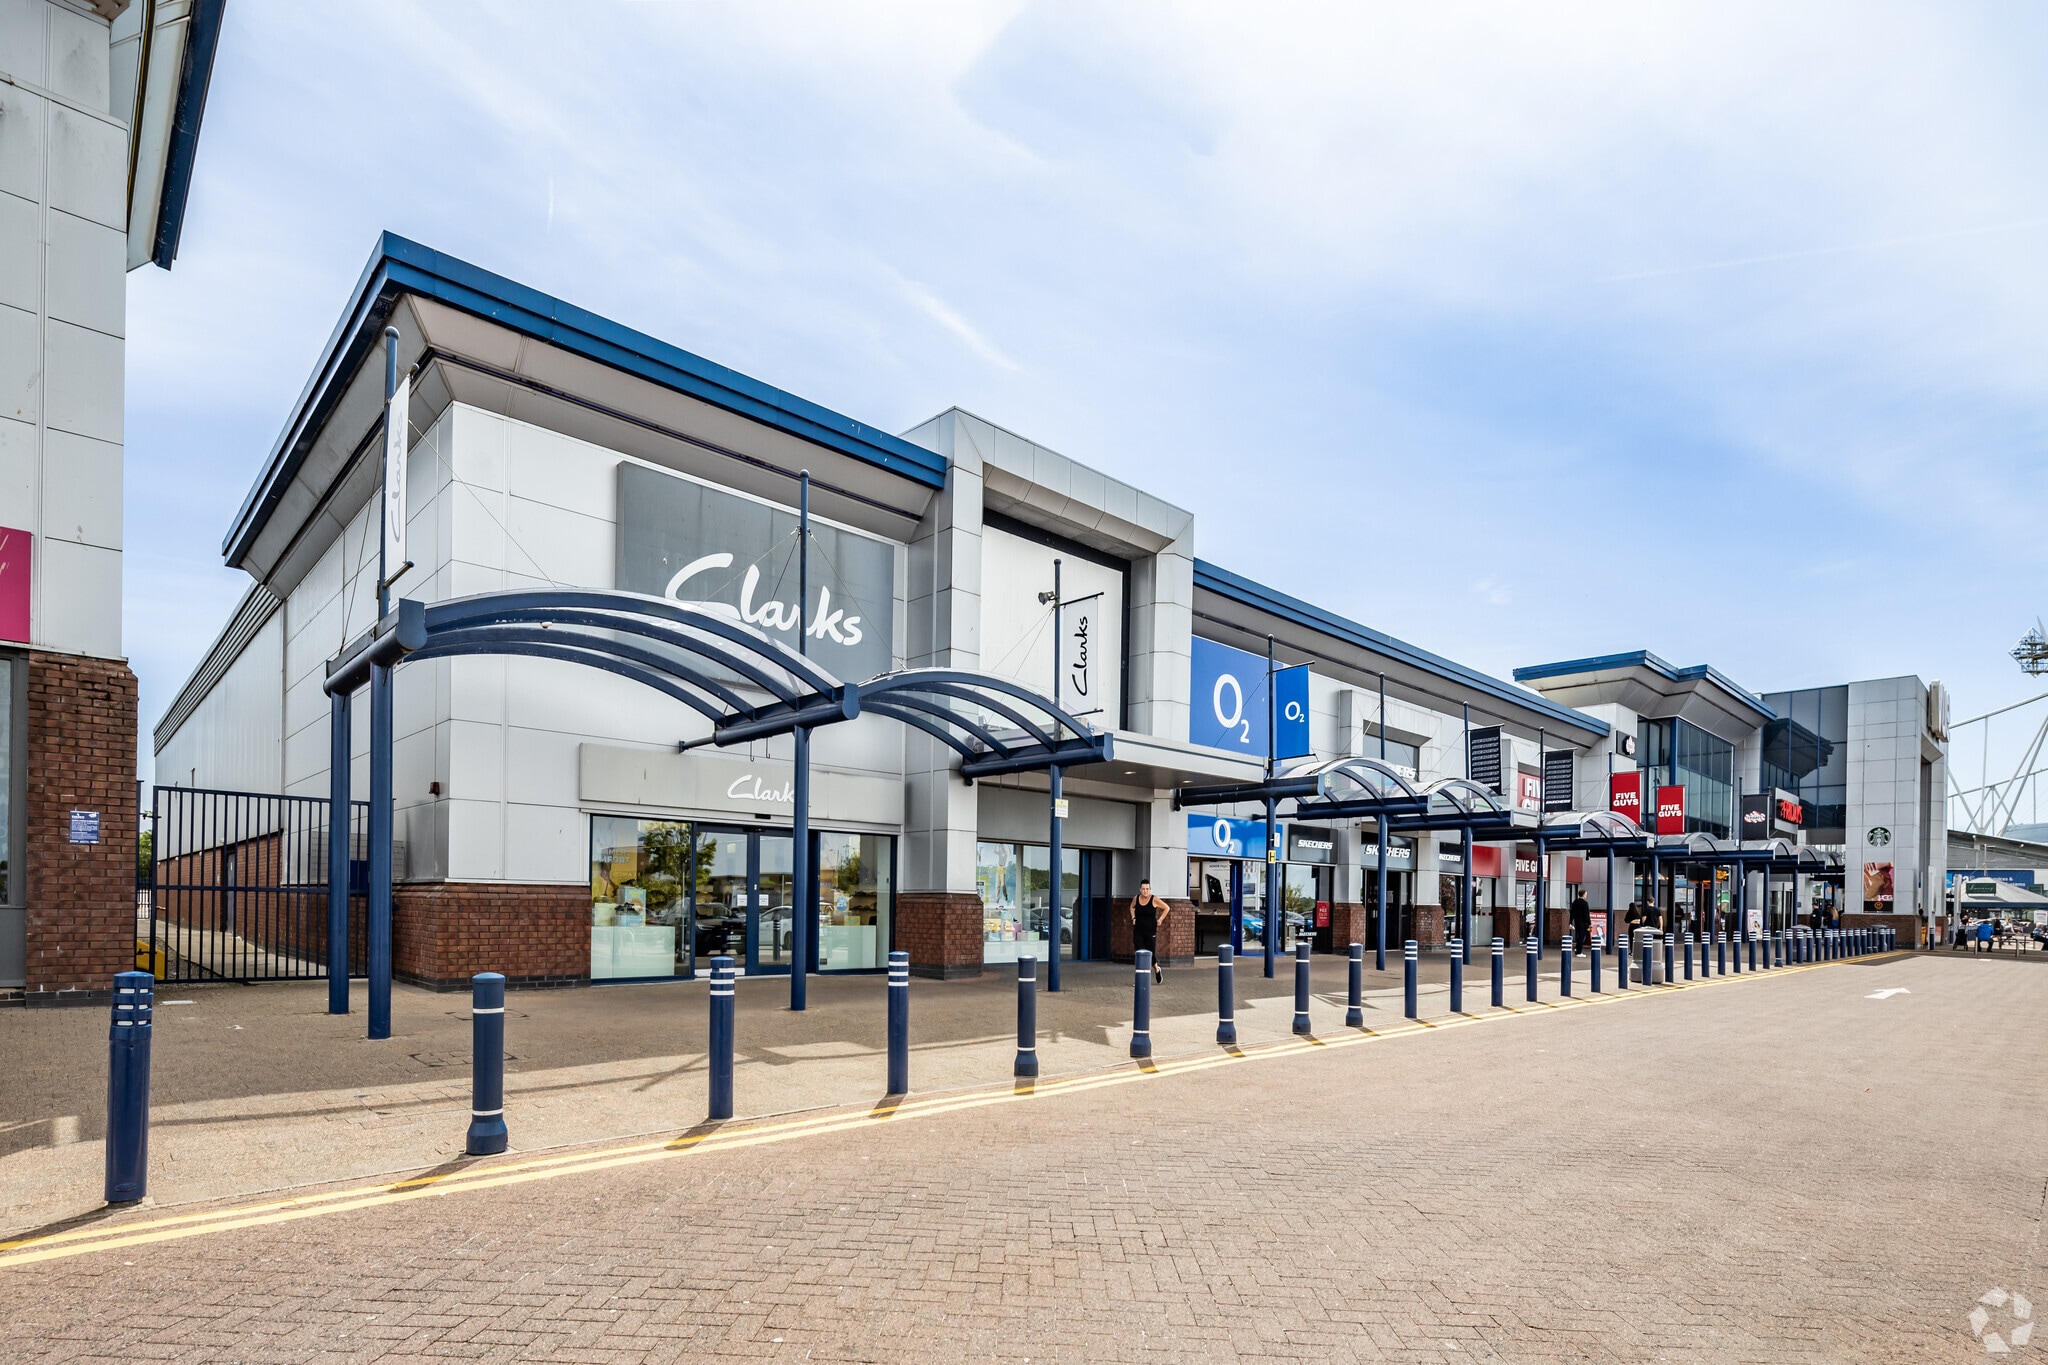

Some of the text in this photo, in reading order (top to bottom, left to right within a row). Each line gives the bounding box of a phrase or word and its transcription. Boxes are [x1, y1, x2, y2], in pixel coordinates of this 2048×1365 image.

[391, 410, 404, 544] Clarks
[664, 552, 864, 647] Clarks
[1071, 615, 1089, 696] Clarks
[727, 774, 795, 803] Clark
[1613, 798, 1639, 807] GUYS
[1615, 792, 1637, 800] FIVE
[1658, 810, 1682, 818] GUYS
[1660, 804, 1680, 812] FIVE
[1297, 839, 1334, 850] SKECHERS
[1365, 845, 1411, 859] SKCHERS
[1515, 859, 1530, 872] FIVE
